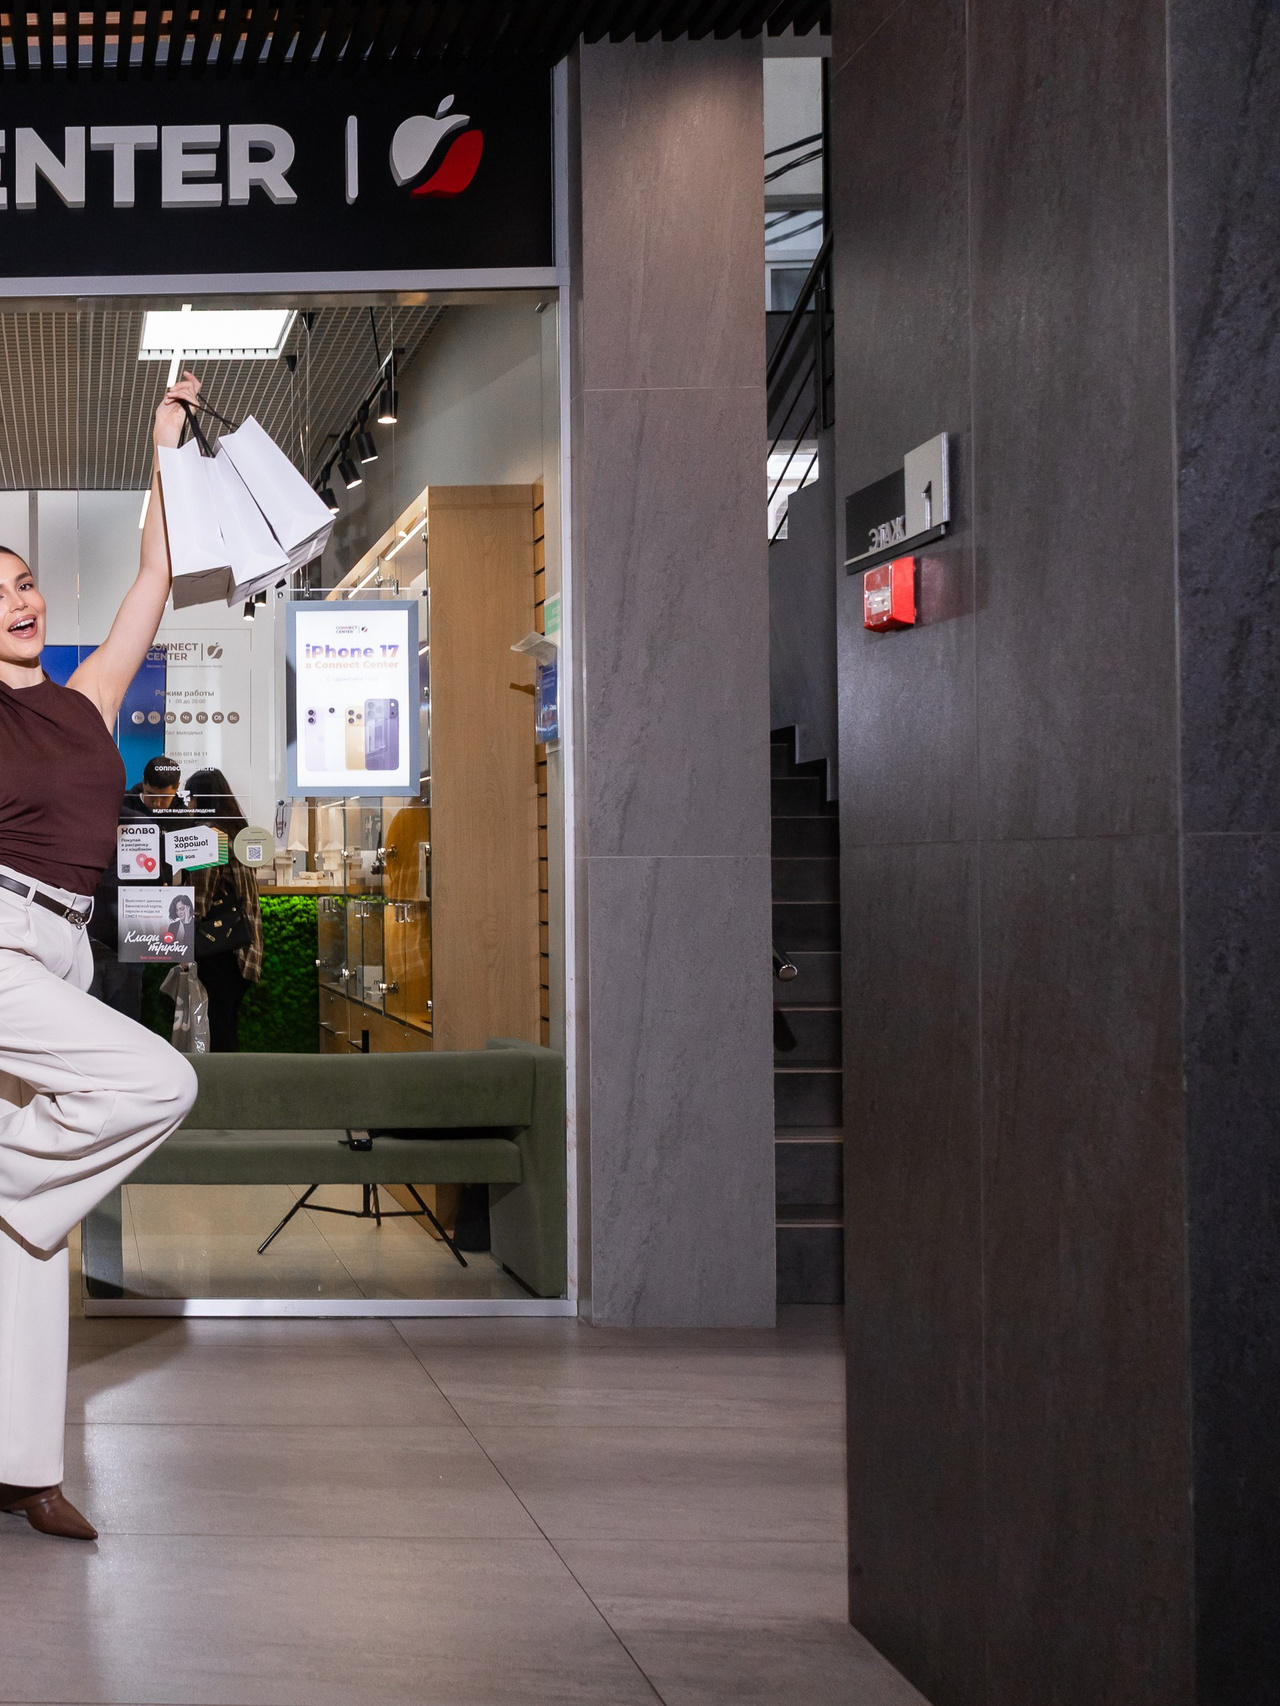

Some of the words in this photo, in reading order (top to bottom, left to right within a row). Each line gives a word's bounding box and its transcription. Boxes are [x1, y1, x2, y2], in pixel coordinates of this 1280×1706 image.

[921, 480, 933, 530] 1
[868, 514, 907, 550] ЭТАЖ
[146, 652, 188, 661] CENTER
[305, 644, 375, 659] iPhone
[380, 644, 400, 658] 17
[315, 660, 360, 670] Connect
[363, 660, 399, 670] Center
[184, 689, 214, 698] работы
[173, 834, 199, 843] Здесь
[174, 839, 209, 849] хорошо!
[124, 930, 161, 946] Клади
[148, 940, 189, 956] трубку
